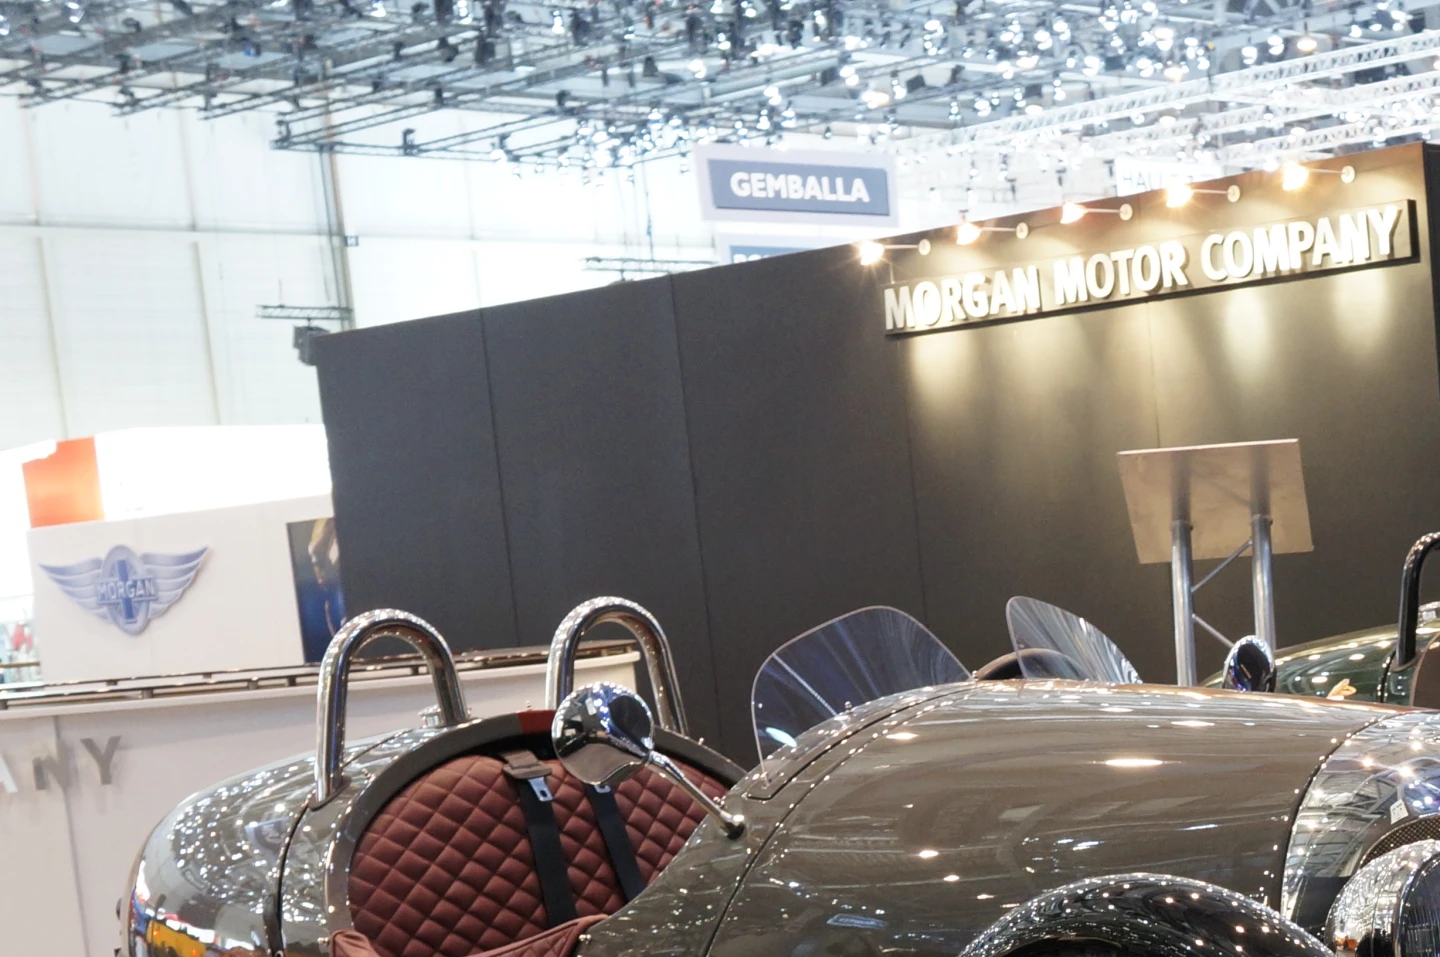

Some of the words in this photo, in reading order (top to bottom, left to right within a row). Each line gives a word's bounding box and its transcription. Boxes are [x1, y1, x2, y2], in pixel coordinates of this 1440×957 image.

[730, 171, 871, 203] GEMBALLA
[884, 264, 1041, 331] MORGAN
[1053, 240, 1189, 305] MOTOR
[1200, 205, 1404, 281] COMPANY
[97, 577, 156, 601] MORGAN
